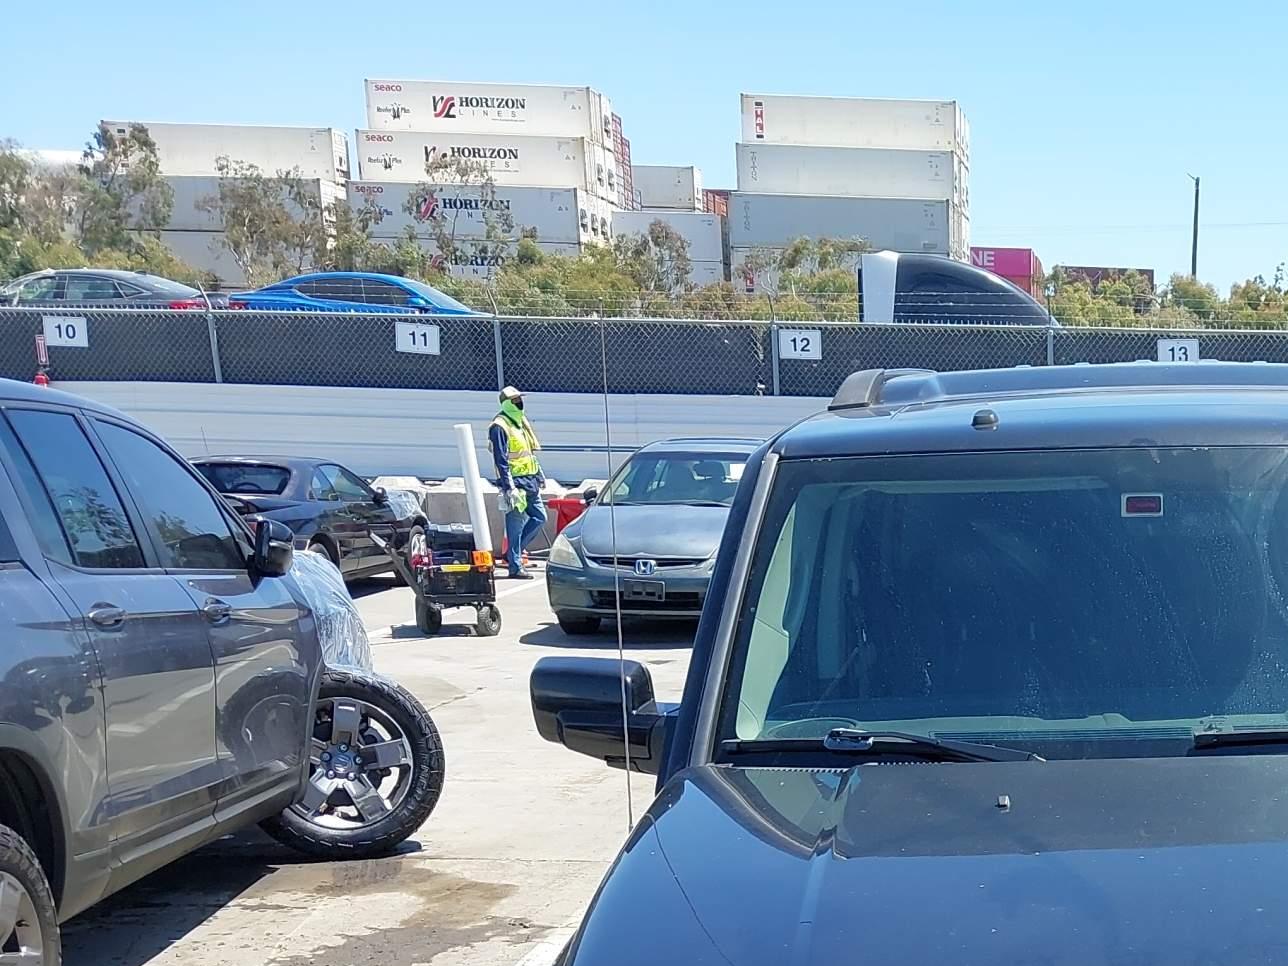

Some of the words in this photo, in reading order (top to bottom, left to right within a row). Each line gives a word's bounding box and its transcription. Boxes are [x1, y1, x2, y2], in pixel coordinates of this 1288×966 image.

[374, 84, 402, 92] seaco
[458, 96, 526, 110] HORIZON
[458, 109, 517, 118] LINES
[365, 134, 394, 142] seaco
[449, 146, 519, 160] HORIZON
[354, 185, 384, 194] seaco
[449, 254, 506, 267] HORIZO
[54, 322, 77, 340] 10
[408, 330, 428, 347] 11
[790, 336, 811, 352] 12
[1167, 346, 1189, 361] 13
